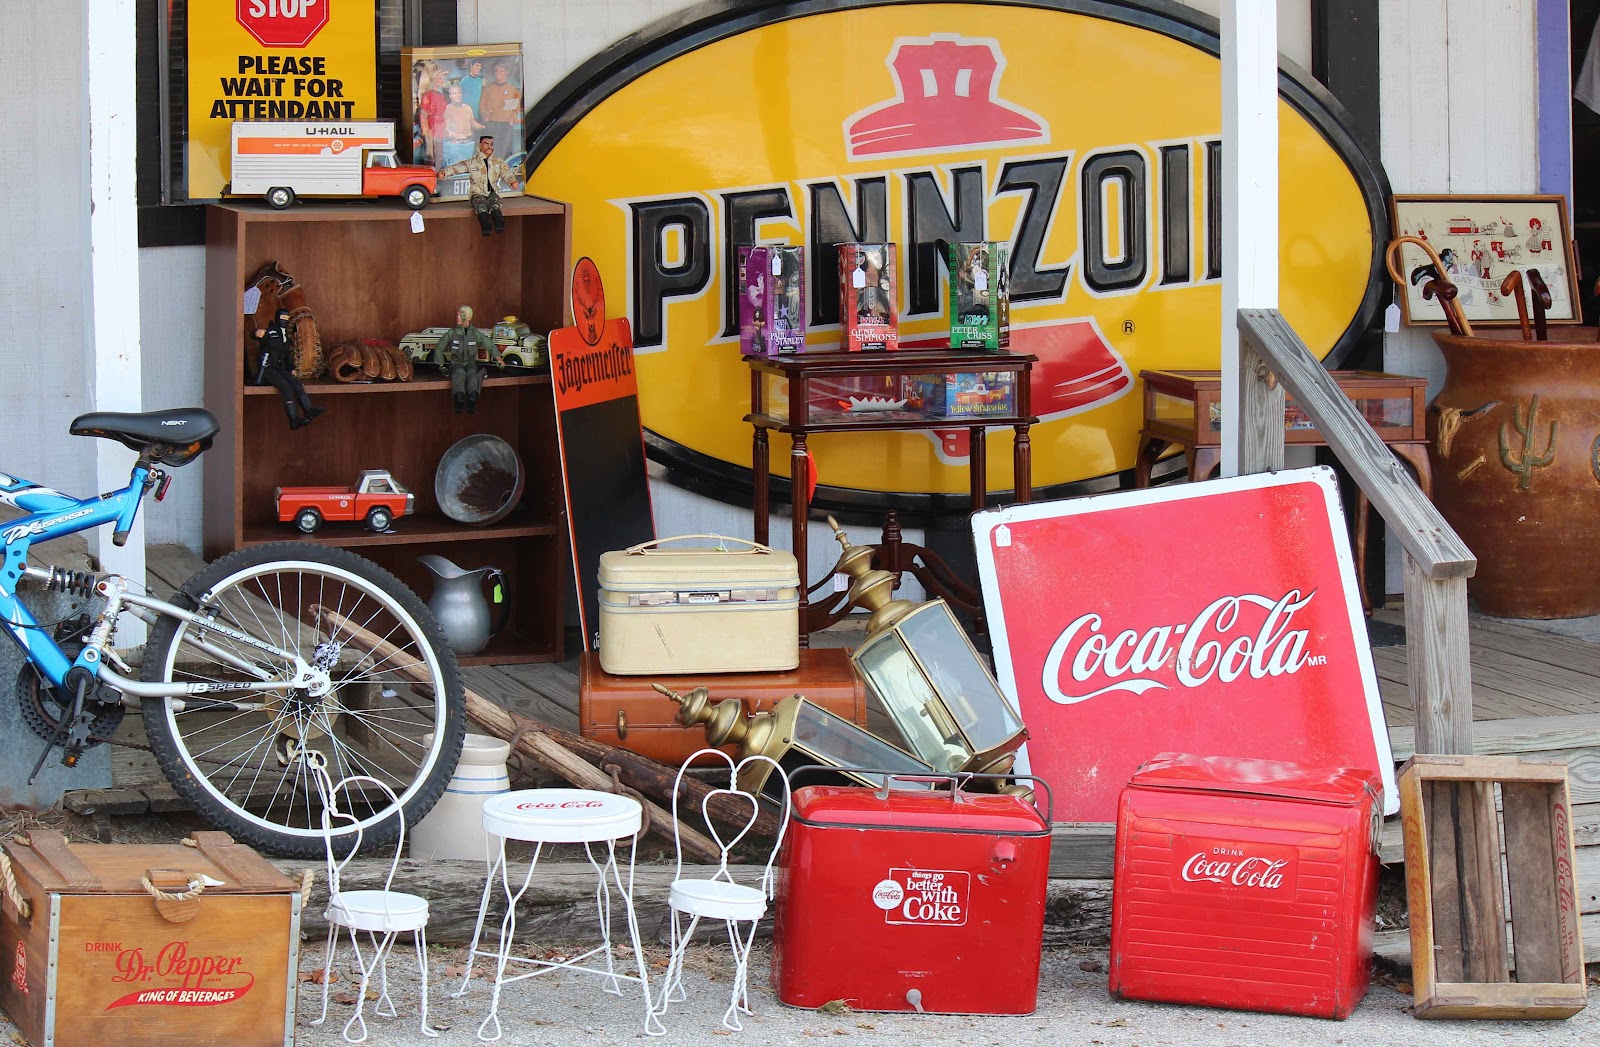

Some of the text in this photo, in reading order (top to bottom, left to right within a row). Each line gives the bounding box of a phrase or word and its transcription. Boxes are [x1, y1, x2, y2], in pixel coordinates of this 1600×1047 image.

[238, 56, 326, 75] PLEASE
[220, 77, 344, 98] WAIT FOR
[209, 99, 356, 119] ATTENDANT
[305, 127, 355, 135] U-HAUL
[630, 139, 1222, 348] PENNZOI
[1454, 276, 1473, 285] GAY
[964, 314, 989, 326] KISS
[851, 328, 876, 336] GENE
[951, 326, 978, 334] PETER
[770, 331, 786, 341] PAUL
[775, 336, 805, 346] STANLEY
[855, 333, 897, 341] SIMMONS
[967, 332, 993, 340] CRISS
[31, 507, 94, 532] SUSPENSION
[1041, 586, 1327, 705] Coca-Cola MR
[207, 682, 252, 690] SPEED
[516, 800, 605, 810] Coca-Cola
[1213, 847, 1244, 857] DRINK
[1181, 852, 1289, 889] Coca-Cola
[912, 871, 944, 882] things go
[906, 877, 943, 891] better
[874, 889, 902, 900] Coca-Cola
[921, 885, 958, 903] with
[903, 896, 961, 921] Coke
[85, 942, 122, 952] DRINK
[1560, 914, 1570, 971] BOTTLES
[111, 941, 244, 988] Dr. Pepper
[137, 990, 235, 1003] KING OF BEVERAGES
